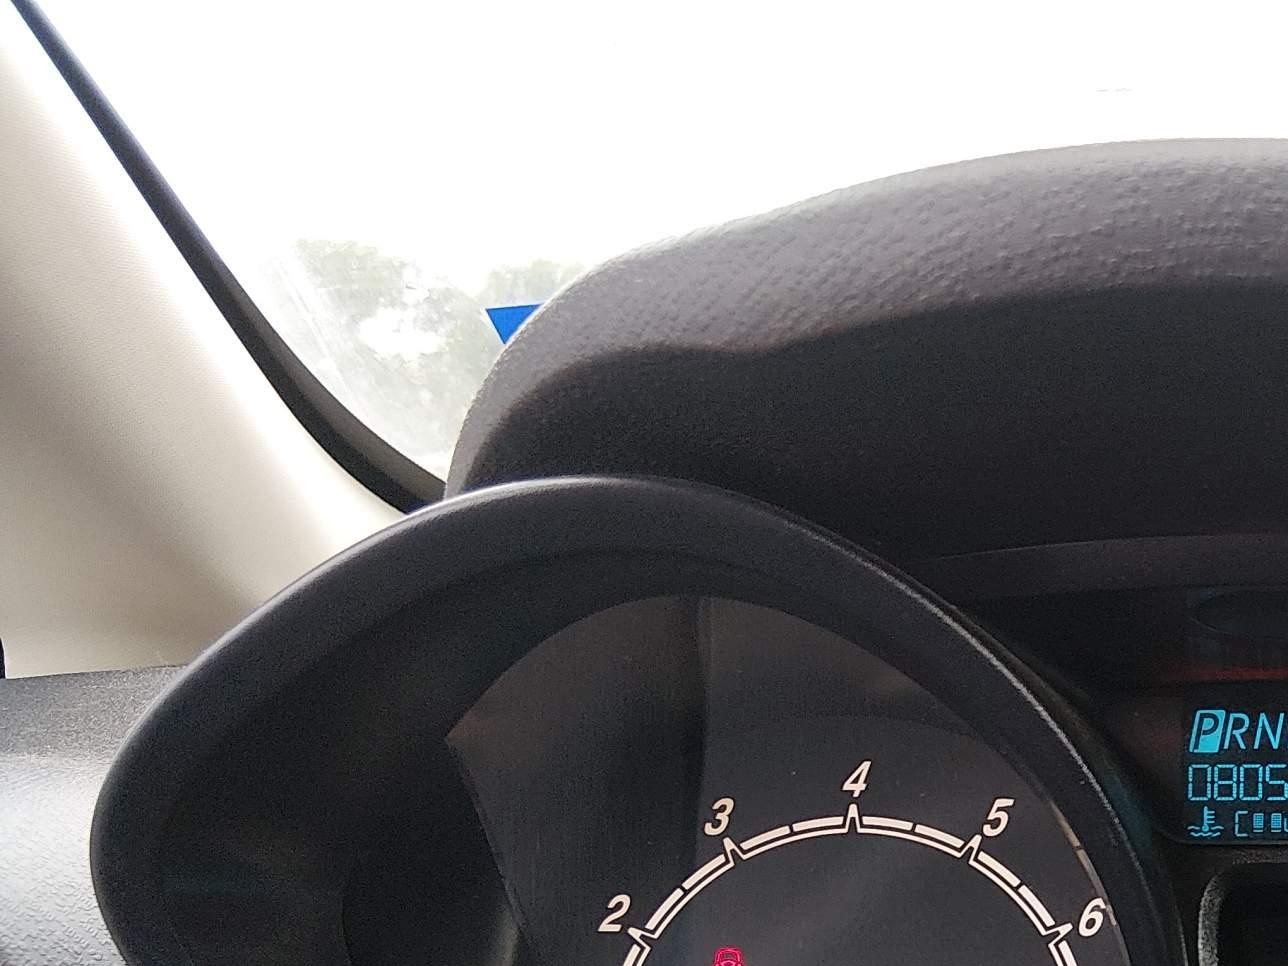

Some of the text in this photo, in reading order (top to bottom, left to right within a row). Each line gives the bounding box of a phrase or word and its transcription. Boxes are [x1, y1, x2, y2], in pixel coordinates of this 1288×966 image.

[842, 761, 872, 797] 4
[704, 798, 734, 836] 3
[982, 799, 1014, 837] 5
[598, 895, 631, 932] 2
[1078, 898, 1106, 937] 6
